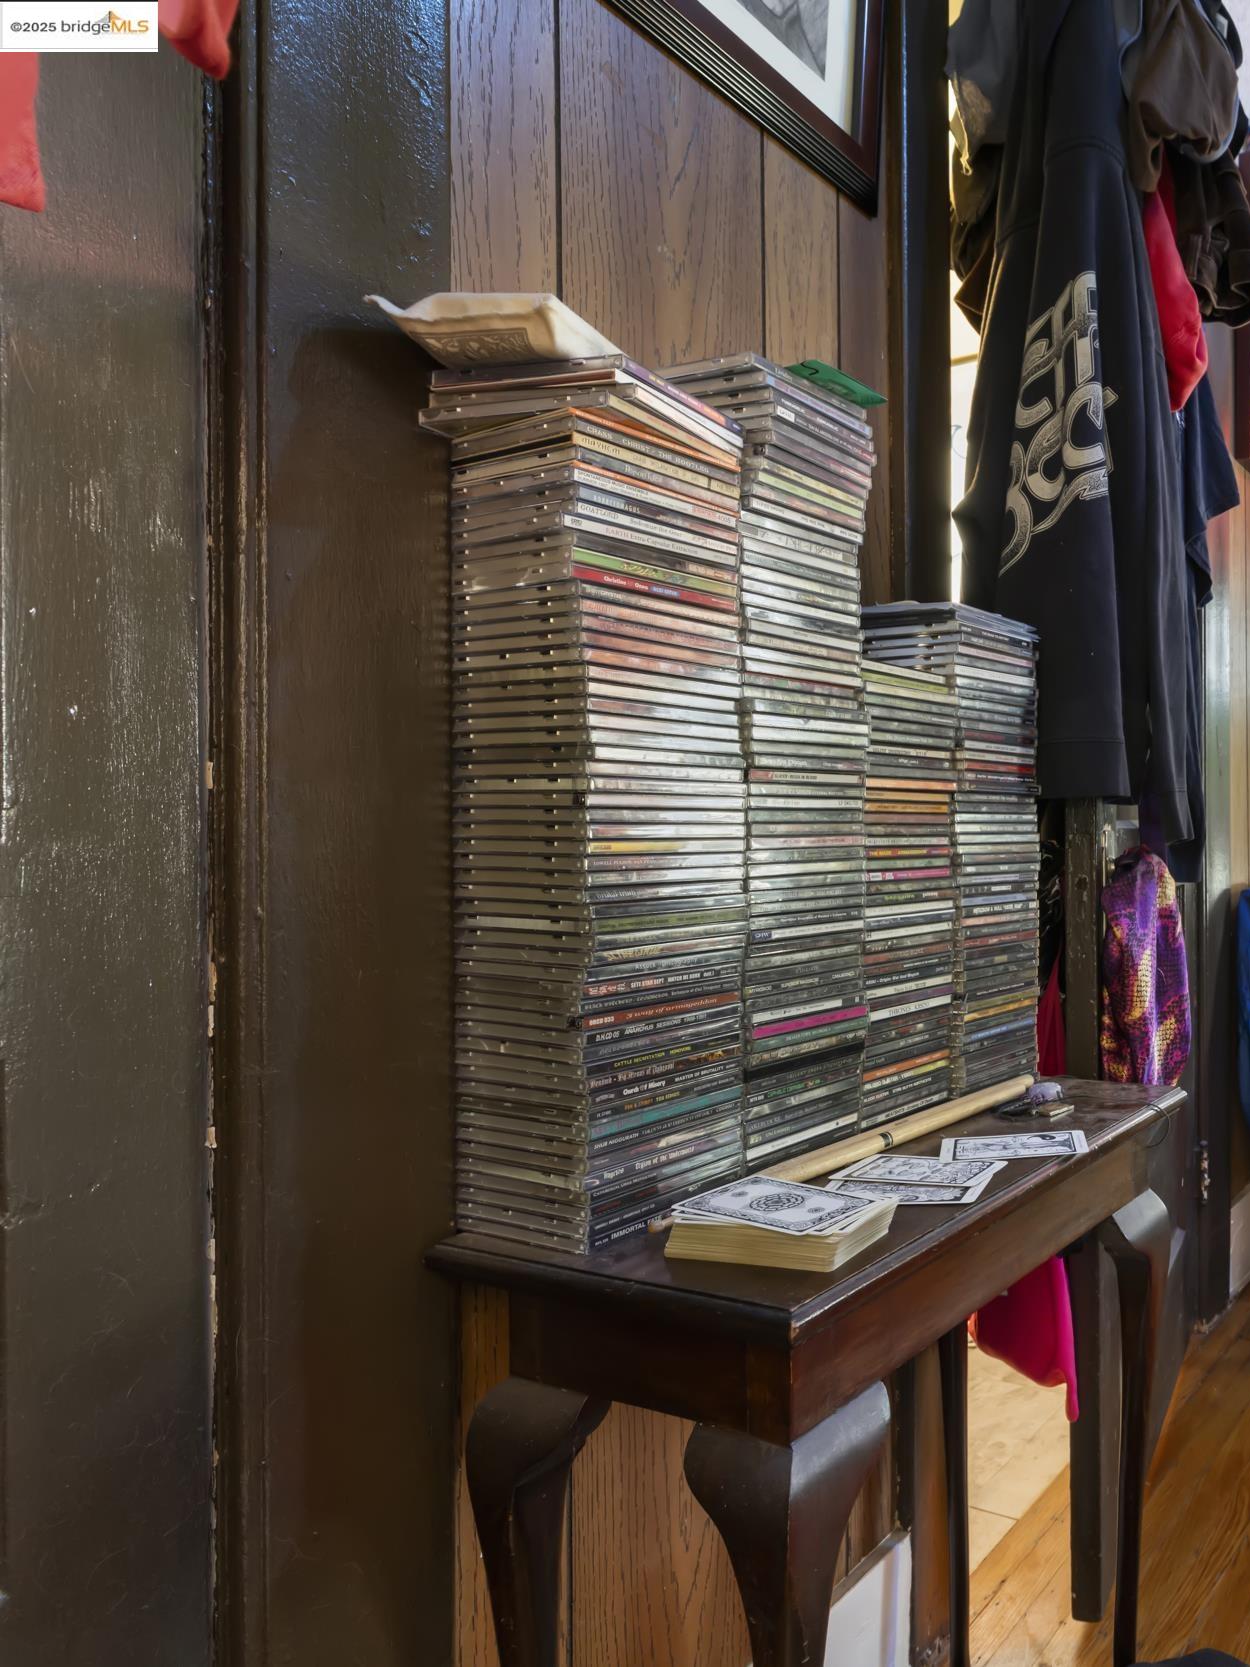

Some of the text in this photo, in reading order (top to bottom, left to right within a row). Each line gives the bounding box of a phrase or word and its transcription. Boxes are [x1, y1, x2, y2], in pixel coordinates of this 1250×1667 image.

[580, 502, 619, 520] GOATLORD
[605, 527, 630, 540] EARTH
[603, 575, 627, 586] Christine
[665, 998, 717, 1012] armageddon
[675, 1074, 693, 1083] MASTER
[701, 1066, 725, 1077] BRUTALITY
[610, 1222, 646, 1241] IMMORTAL
